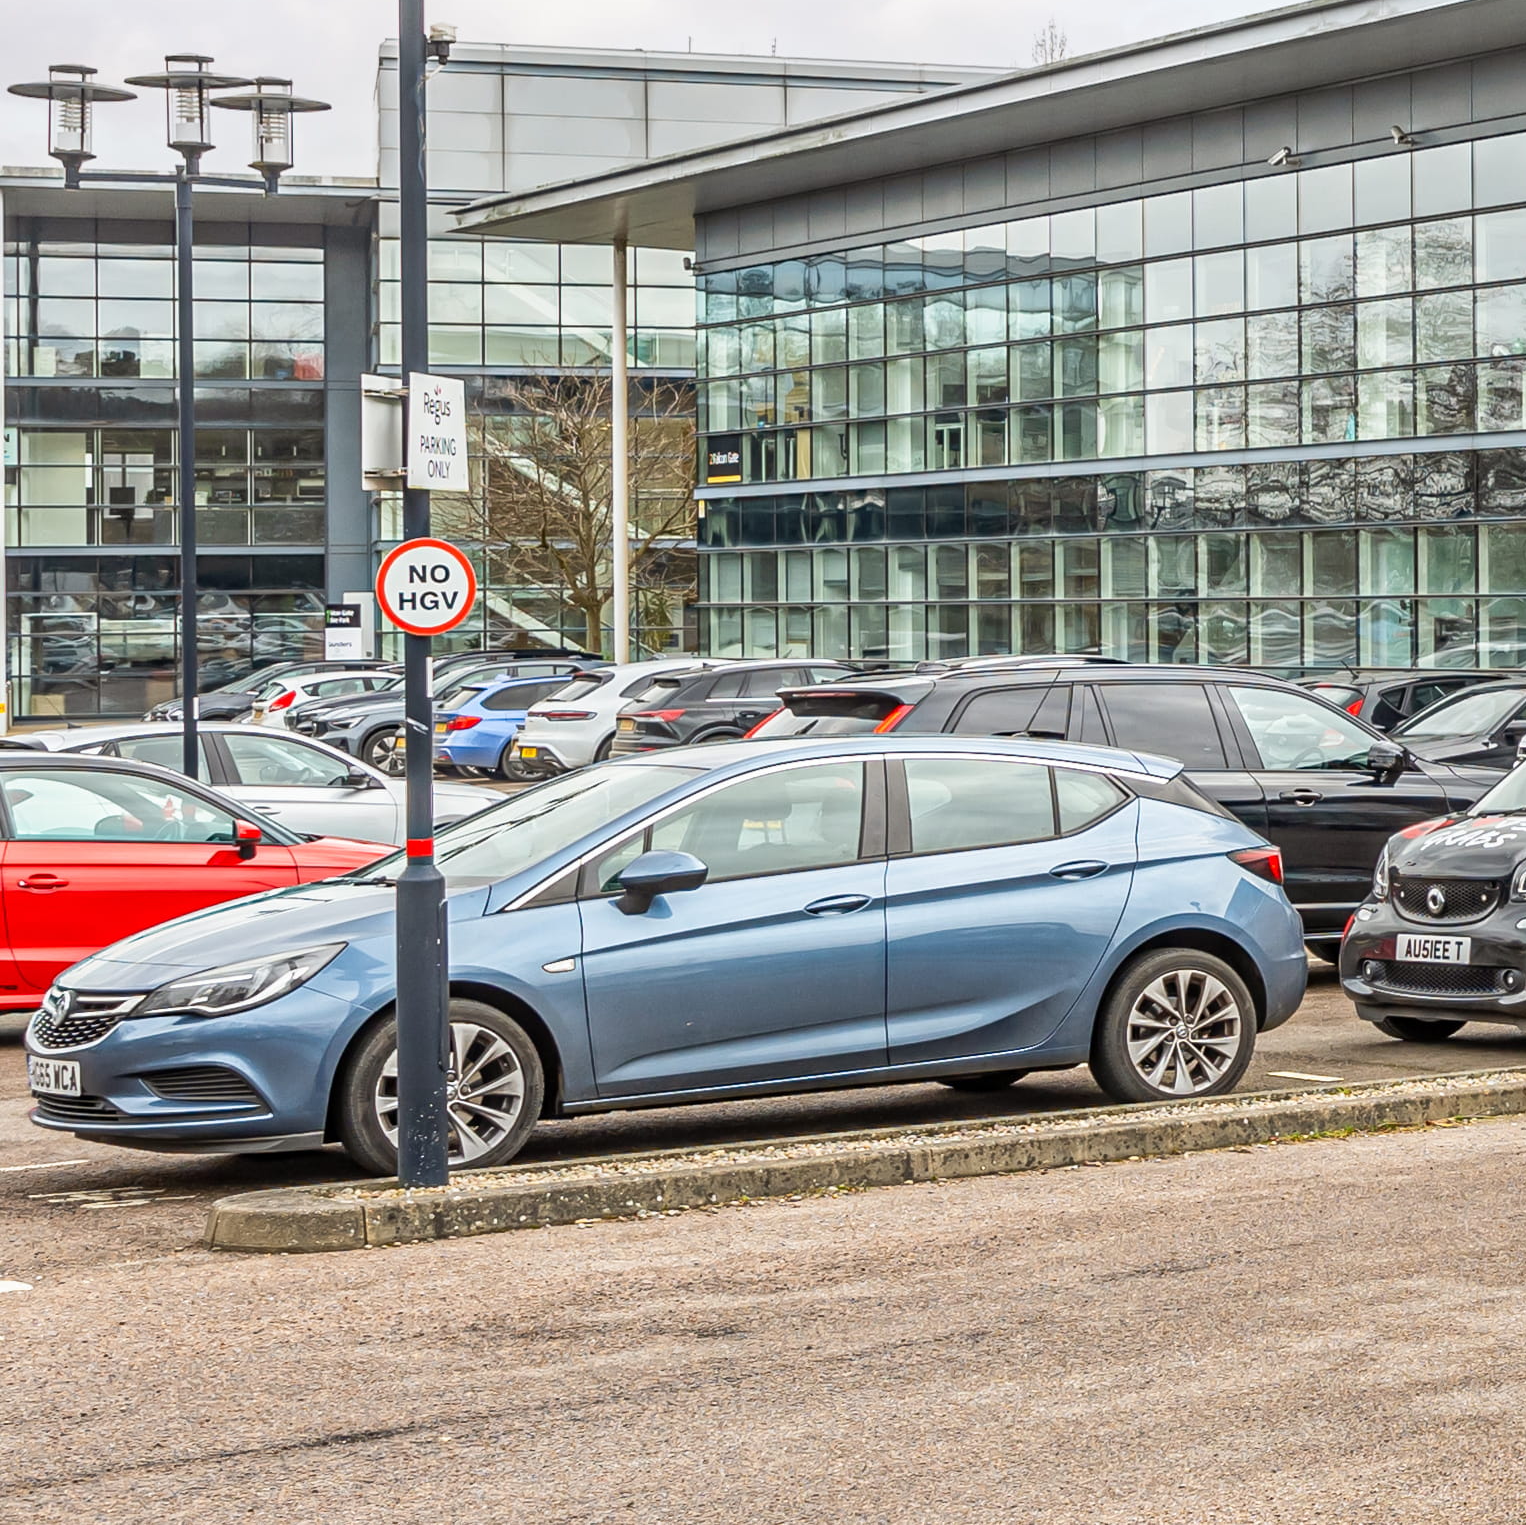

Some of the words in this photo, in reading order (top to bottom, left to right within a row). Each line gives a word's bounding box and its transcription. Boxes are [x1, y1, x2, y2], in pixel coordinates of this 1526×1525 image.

[424, 391, 451, 425] Regus
[420, 435, 457, 456] PARKING
[428, 460, 451, 478] ONLY
[409, 564, 450, 584] NO
[398, 591, 459, 611] HGV
